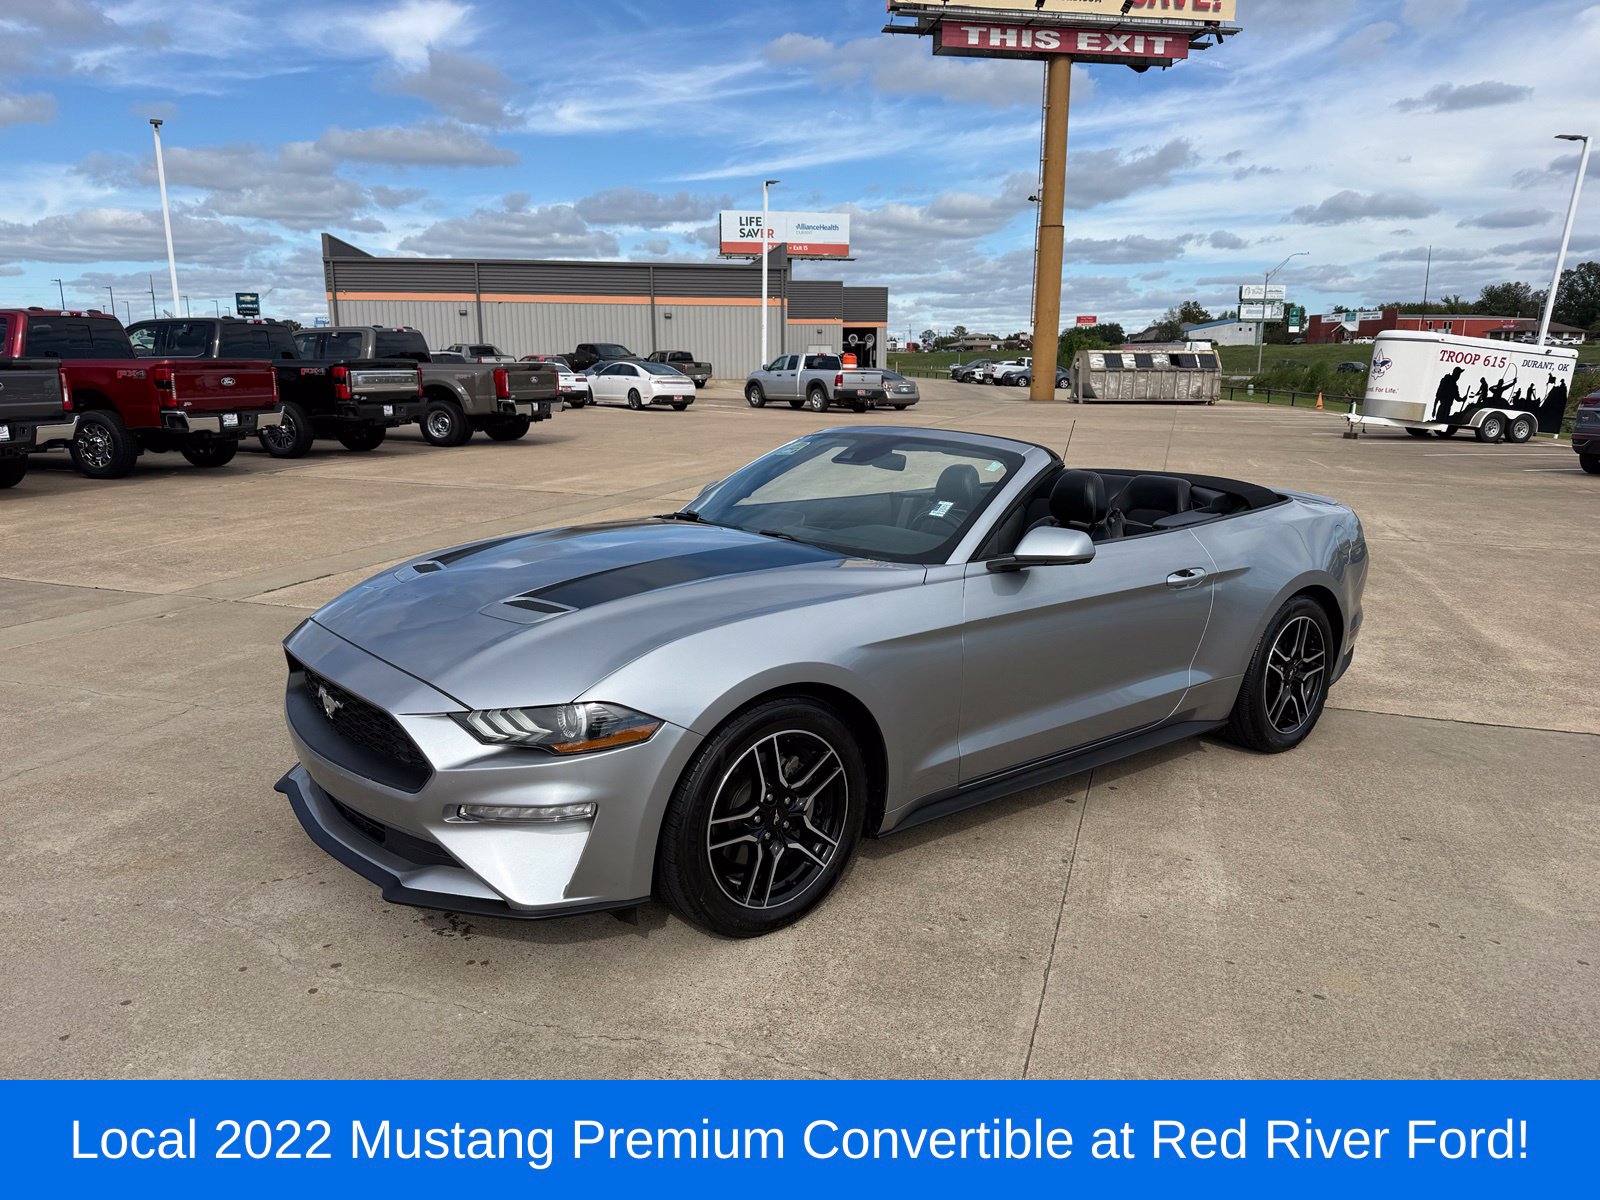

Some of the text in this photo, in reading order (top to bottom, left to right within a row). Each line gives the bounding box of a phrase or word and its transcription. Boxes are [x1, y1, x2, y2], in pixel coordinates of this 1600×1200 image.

[960, 26, 1173, 55] THIS EXIT
[739, 216, 763, 227] LIFE
[796, 223, 840, 231] AllianceHealth
[1439, 349, 1507, 369] TROOP 615
[1521, 359, 1570, 372] DURANT, OK
